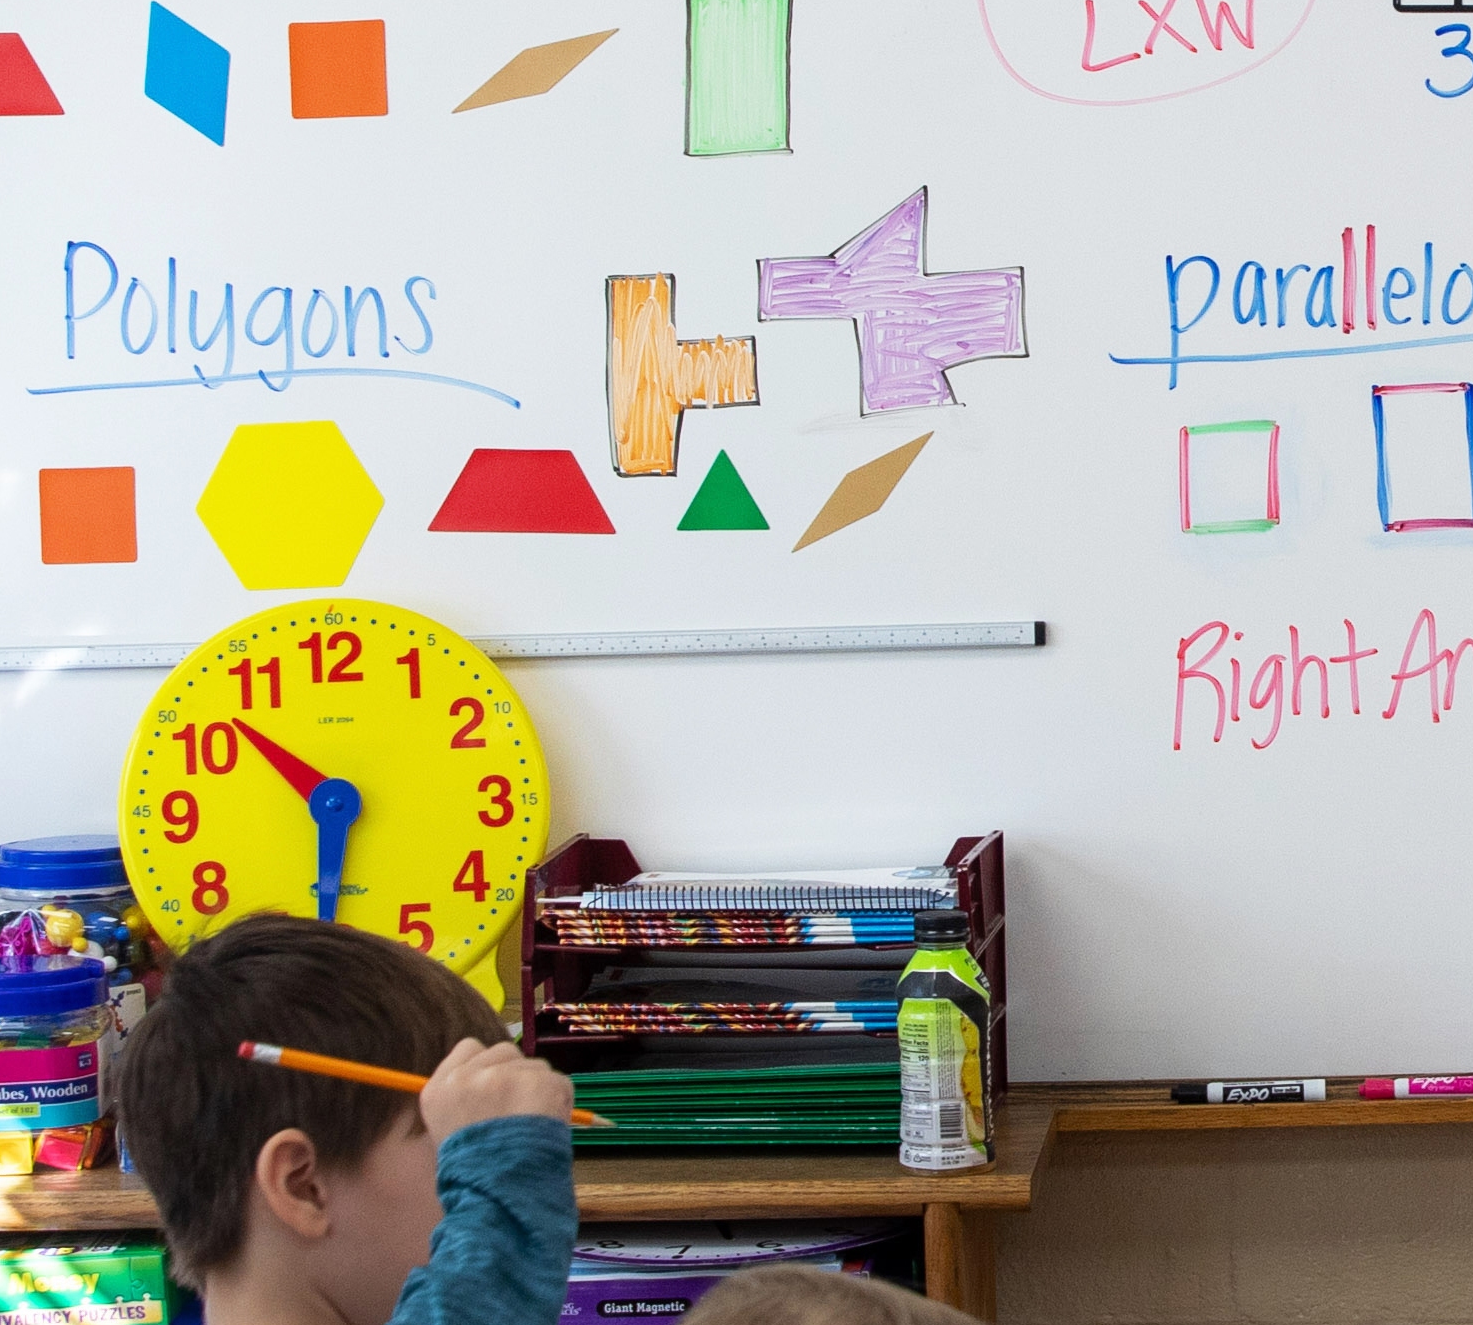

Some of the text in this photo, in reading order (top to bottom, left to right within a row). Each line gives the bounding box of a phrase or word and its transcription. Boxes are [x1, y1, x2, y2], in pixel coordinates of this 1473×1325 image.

[65, 240, 438, 391] Polygons
[299, 631, 364, 683] 12
[1174, 619, 1378, 751] Right
[32, 1083, 88, 1099] Wooden
[1227, 1089, 1269, 1102] EXPO
[79, 1305, 145, 1322] PUZZLES
[604, 1301, 685, 1314] Giant Magnetic
